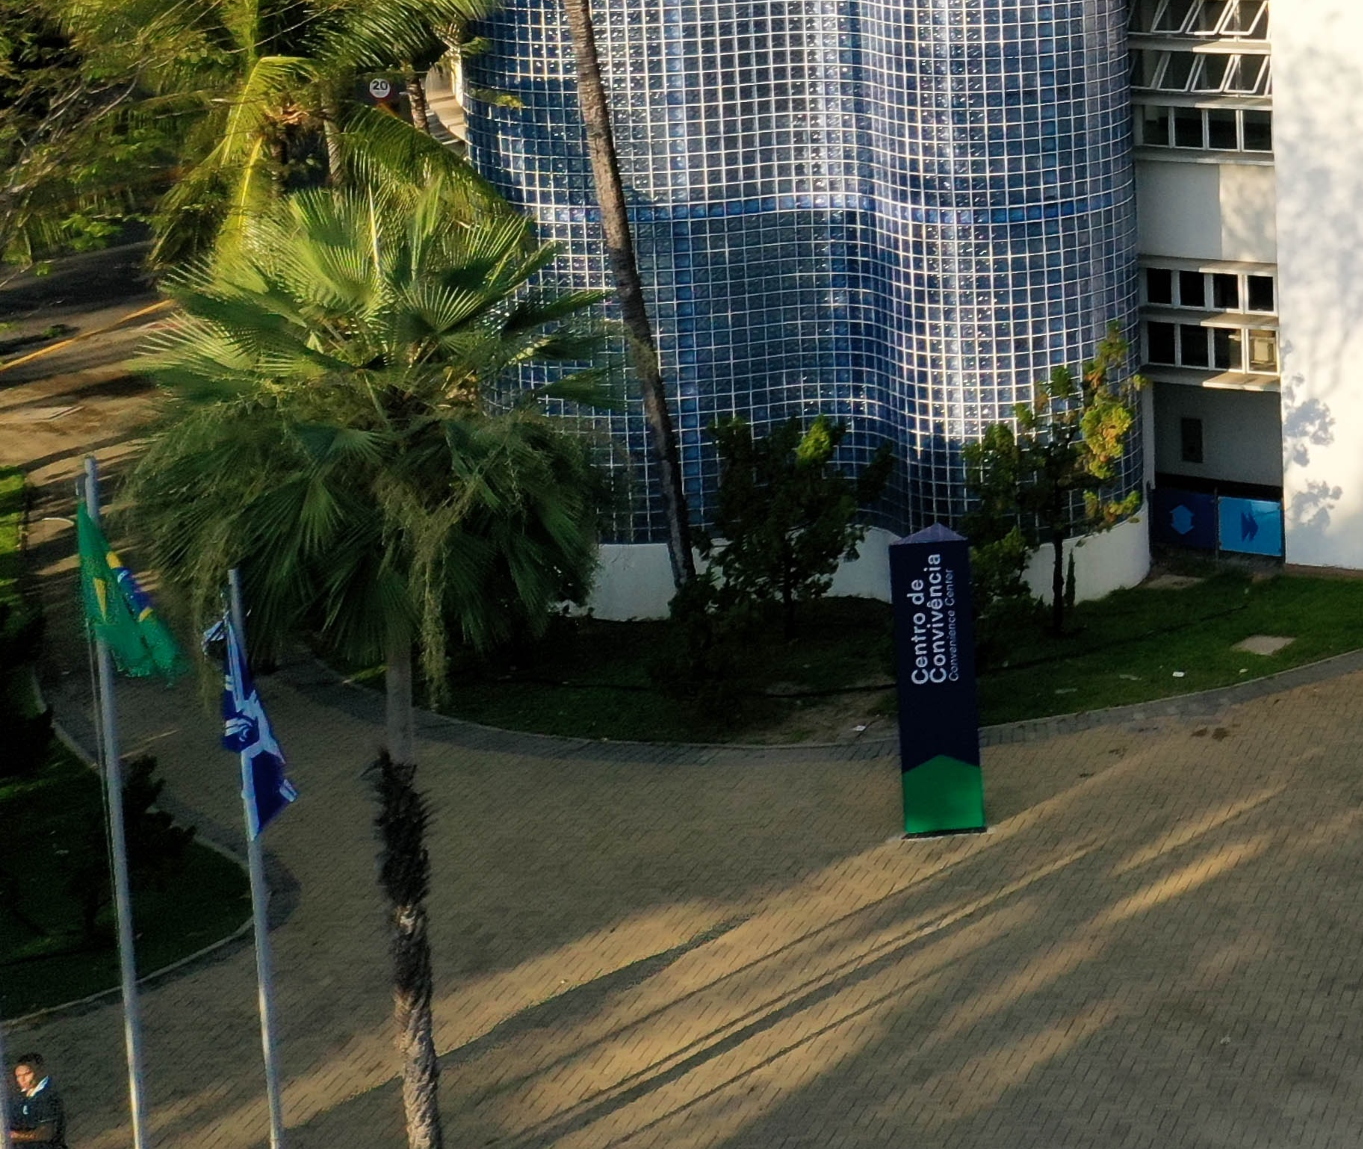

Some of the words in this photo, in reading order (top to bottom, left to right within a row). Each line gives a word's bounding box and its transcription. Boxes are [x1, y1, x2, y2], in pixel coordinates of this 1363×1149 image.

[906, 579, 925, 605] de
[923, 553, 947, 683] Convivência
[944, 568, 955, 606] Center
[911, 612, 929, 685] Centro
[946, 610, 959, 682] Convenience
